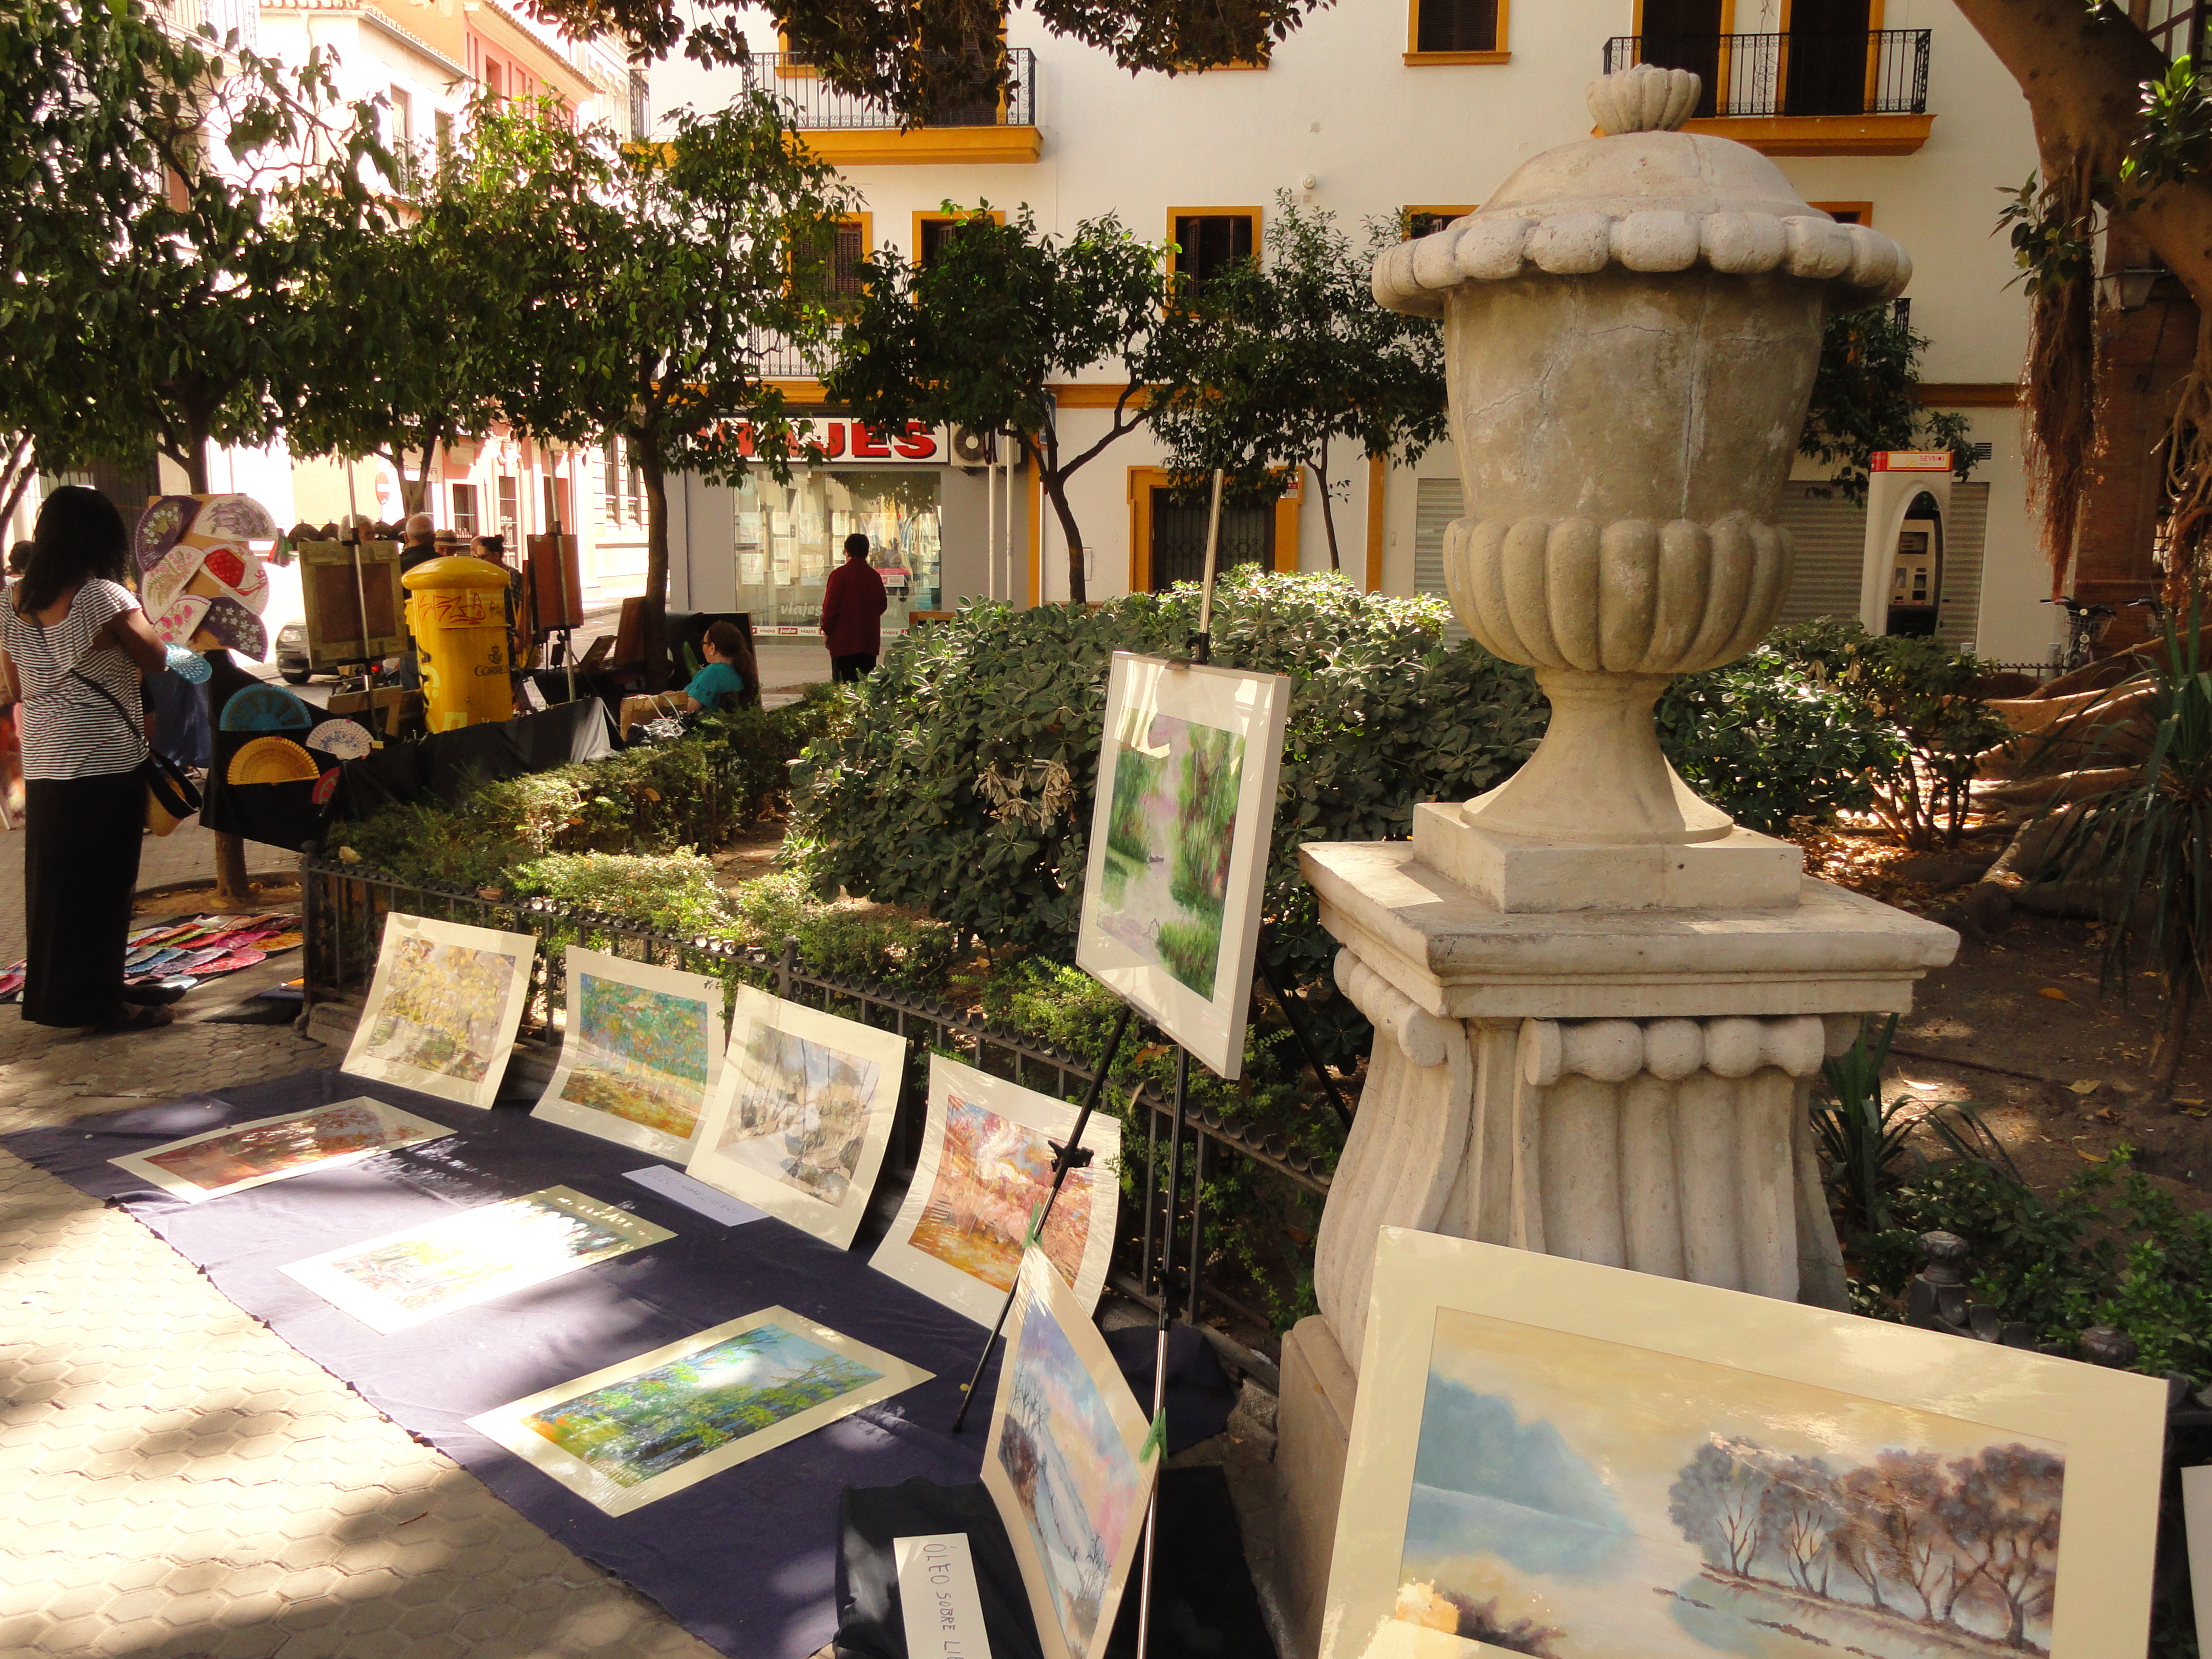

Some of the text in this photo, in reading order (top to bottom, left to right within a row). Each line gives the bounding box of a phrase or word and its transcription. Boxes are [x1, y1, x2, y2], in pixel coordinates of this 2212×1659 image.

[695, 421, 937, 459] IJES
[781, 602, 823, 617] viajes
[923, 1543, 957, 1584] ÓLEO
[937, 1590, 955, 1630] SOBRE
